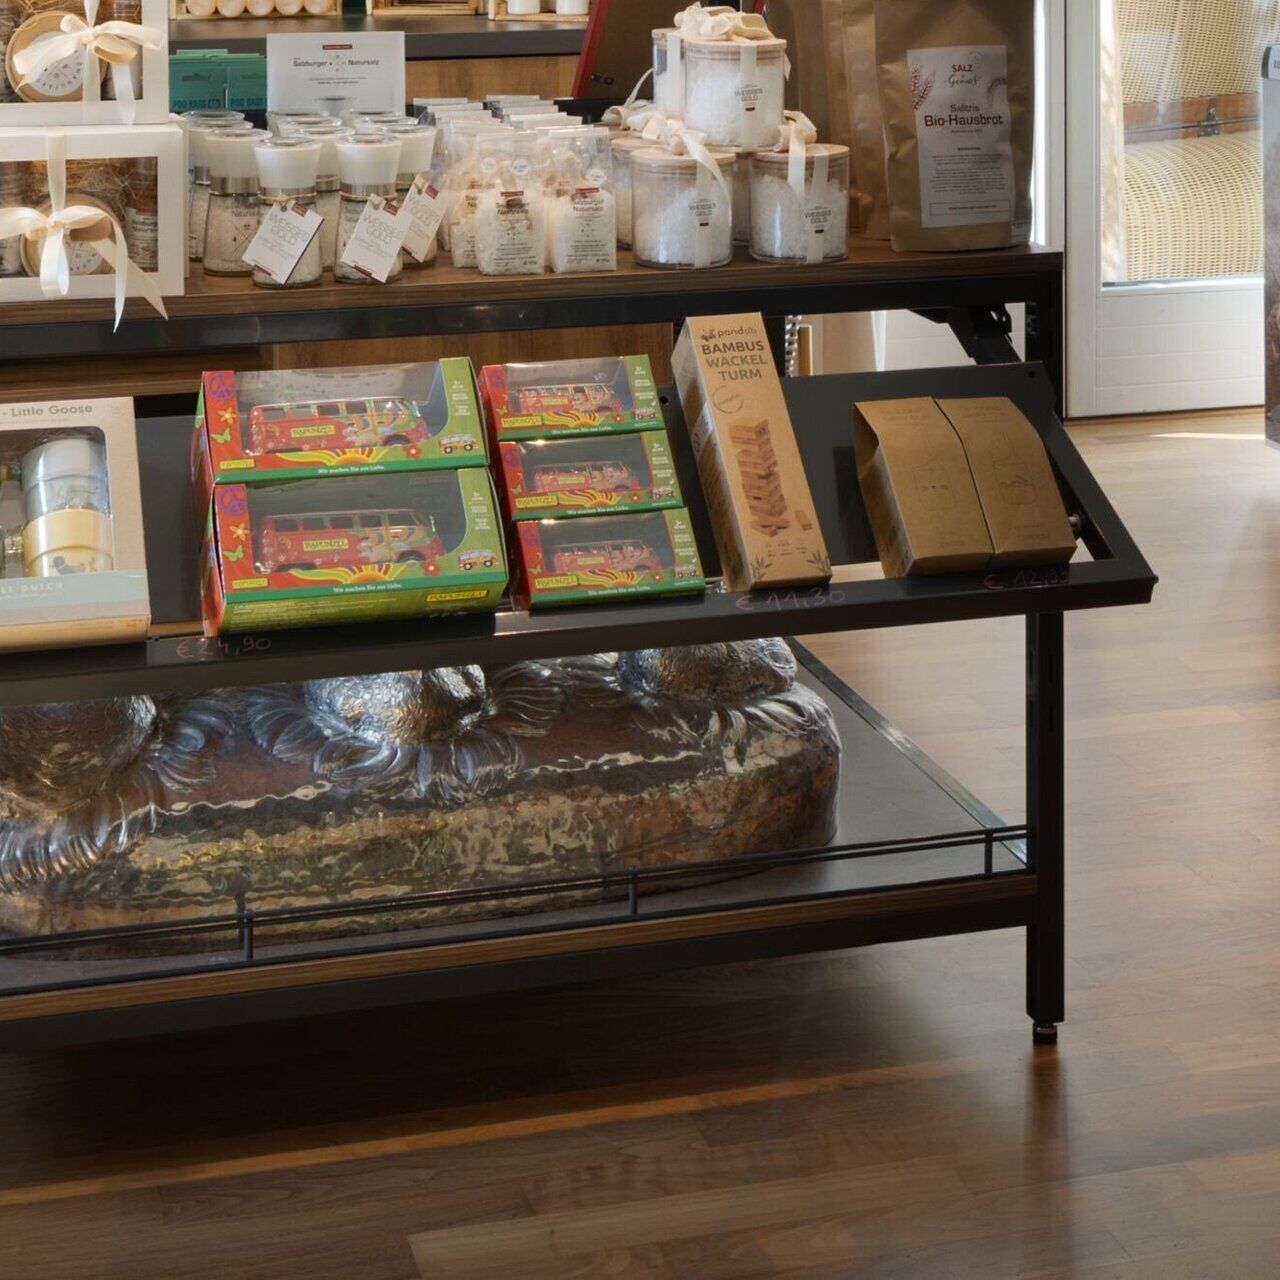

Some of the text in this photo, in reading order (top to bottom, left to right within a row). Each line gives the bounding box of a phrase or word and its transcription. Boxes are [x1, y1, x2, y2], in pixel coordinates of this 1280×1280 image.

[951, 64, 973, 72] SALZ
[950, 104, 980, 113] Salitris
[924, 114, 1004, 127] Bio-Hausbrot
[701, 341, 765, 355] BAMBUS
[706, 355, 768, 368] WACKEL
[718, 369, 762, 381] TURM
[11, 405, 43, 417] Little
[48, 404, 93, 415] Goose
[21, 582, 64, 593] DUTCH
[428, 591, 487, 601] RAPUNZEL
[735, 594, 756, 610] €
[176, 641, 194, 659] €
